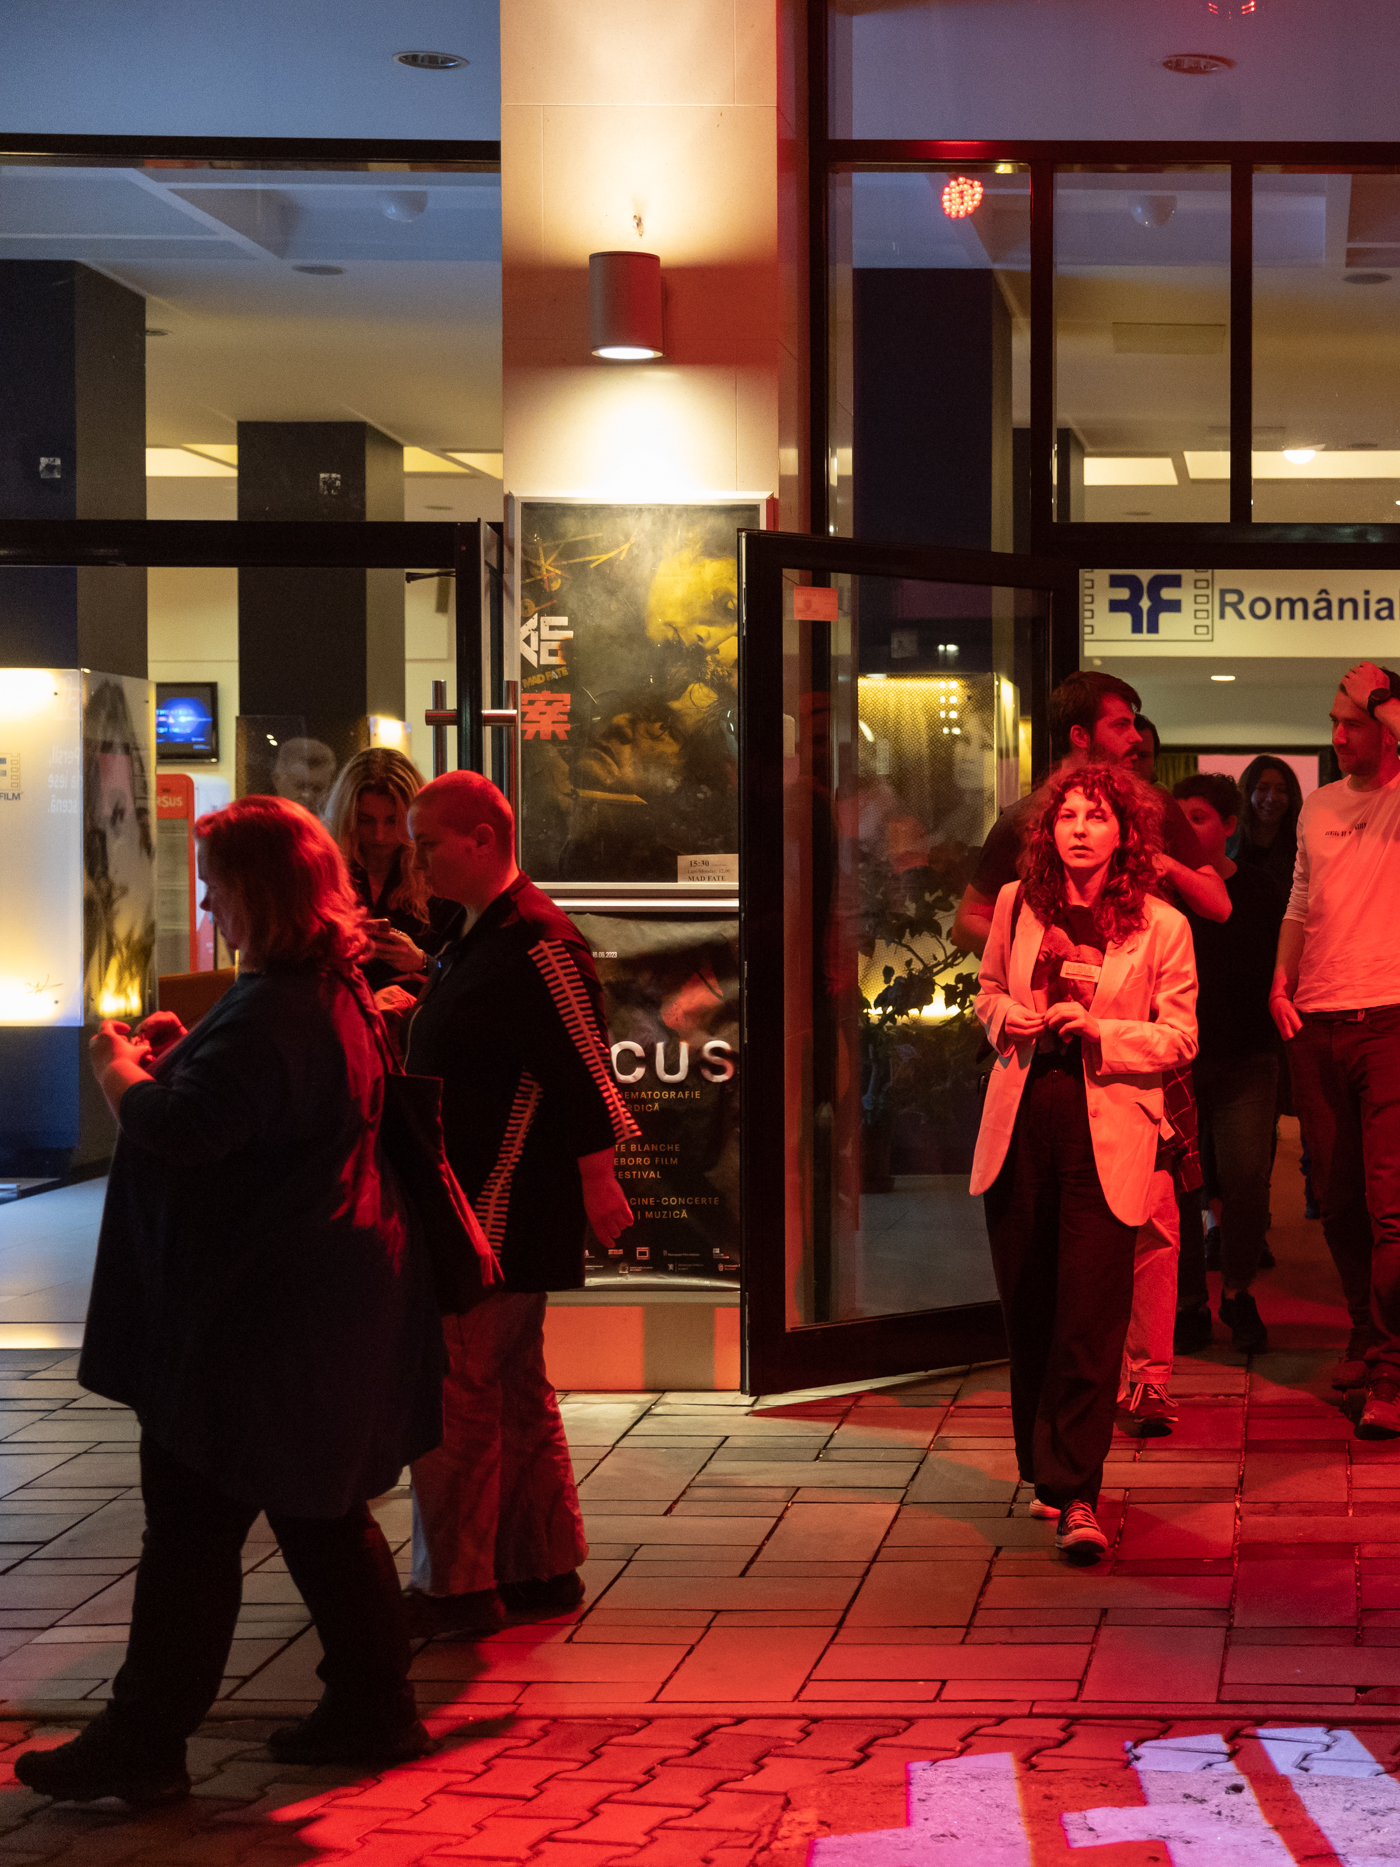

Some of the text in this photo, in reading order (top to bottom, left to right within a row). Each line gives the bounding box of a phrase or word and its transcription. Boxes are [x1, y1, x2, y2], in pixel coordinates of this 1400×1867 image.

[521, 666, 569, 689] MAD FATE
[689, 859, 710, 868] 15:30
[630, 1143, 681, 1152] BLANCHE
[614, 1156, 679, 1166] EBORG FILM
[629, 1196, 720, 1206] CINE-CONCERTE
[645, 1208, 688, 1219] MUZICĂ
